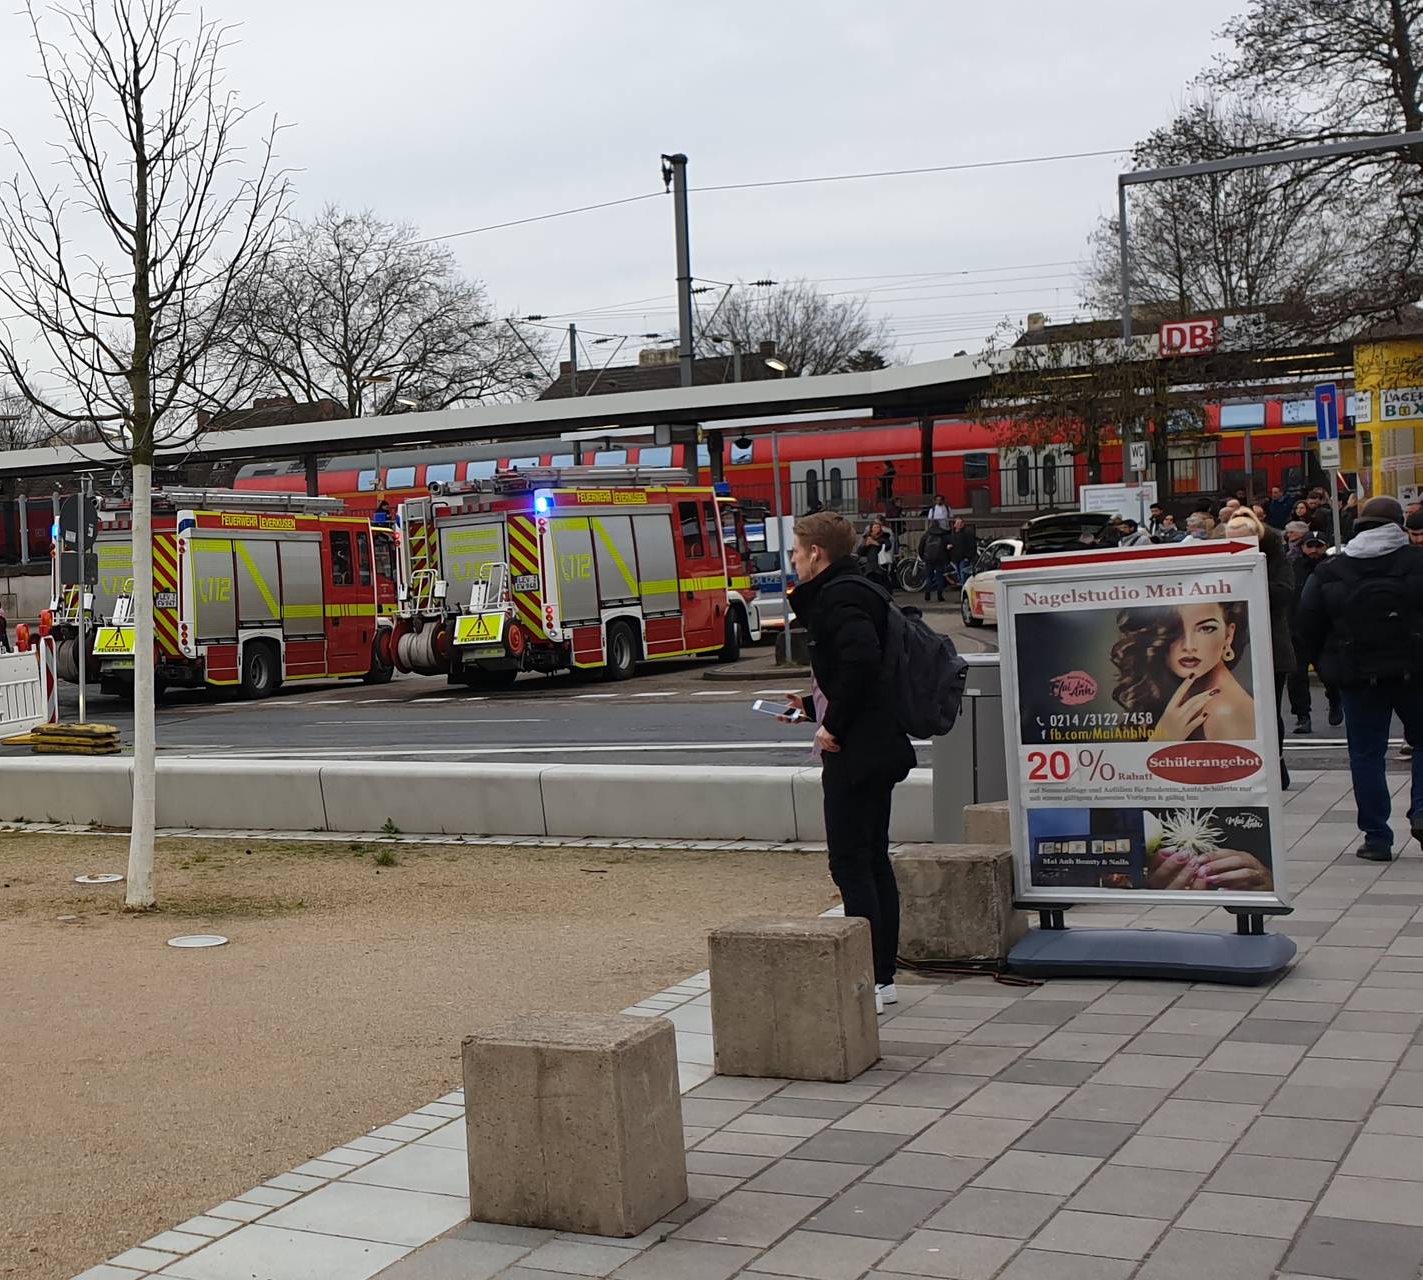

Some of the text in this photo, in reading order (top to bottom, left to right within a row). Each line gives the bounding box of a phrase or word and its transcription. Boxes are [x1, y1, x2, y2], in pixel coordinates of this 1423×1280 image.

[1167, 325, 1211, 351] DB
[1131, 445, 1144, 458] WC
[221, 513, 258, 527] FEUERWEHR
[1024, 579, 1232, 608] Nagelstudio Mai Anh
[460, 635, 497, 643] FEUERWEHR
[1050, 711, 1153, 727] 0214 /3122 7458
[1027, 749, 1153, 781] 20 % Rabatt
[1148, 756, 1261, 769] Schülerangebot
